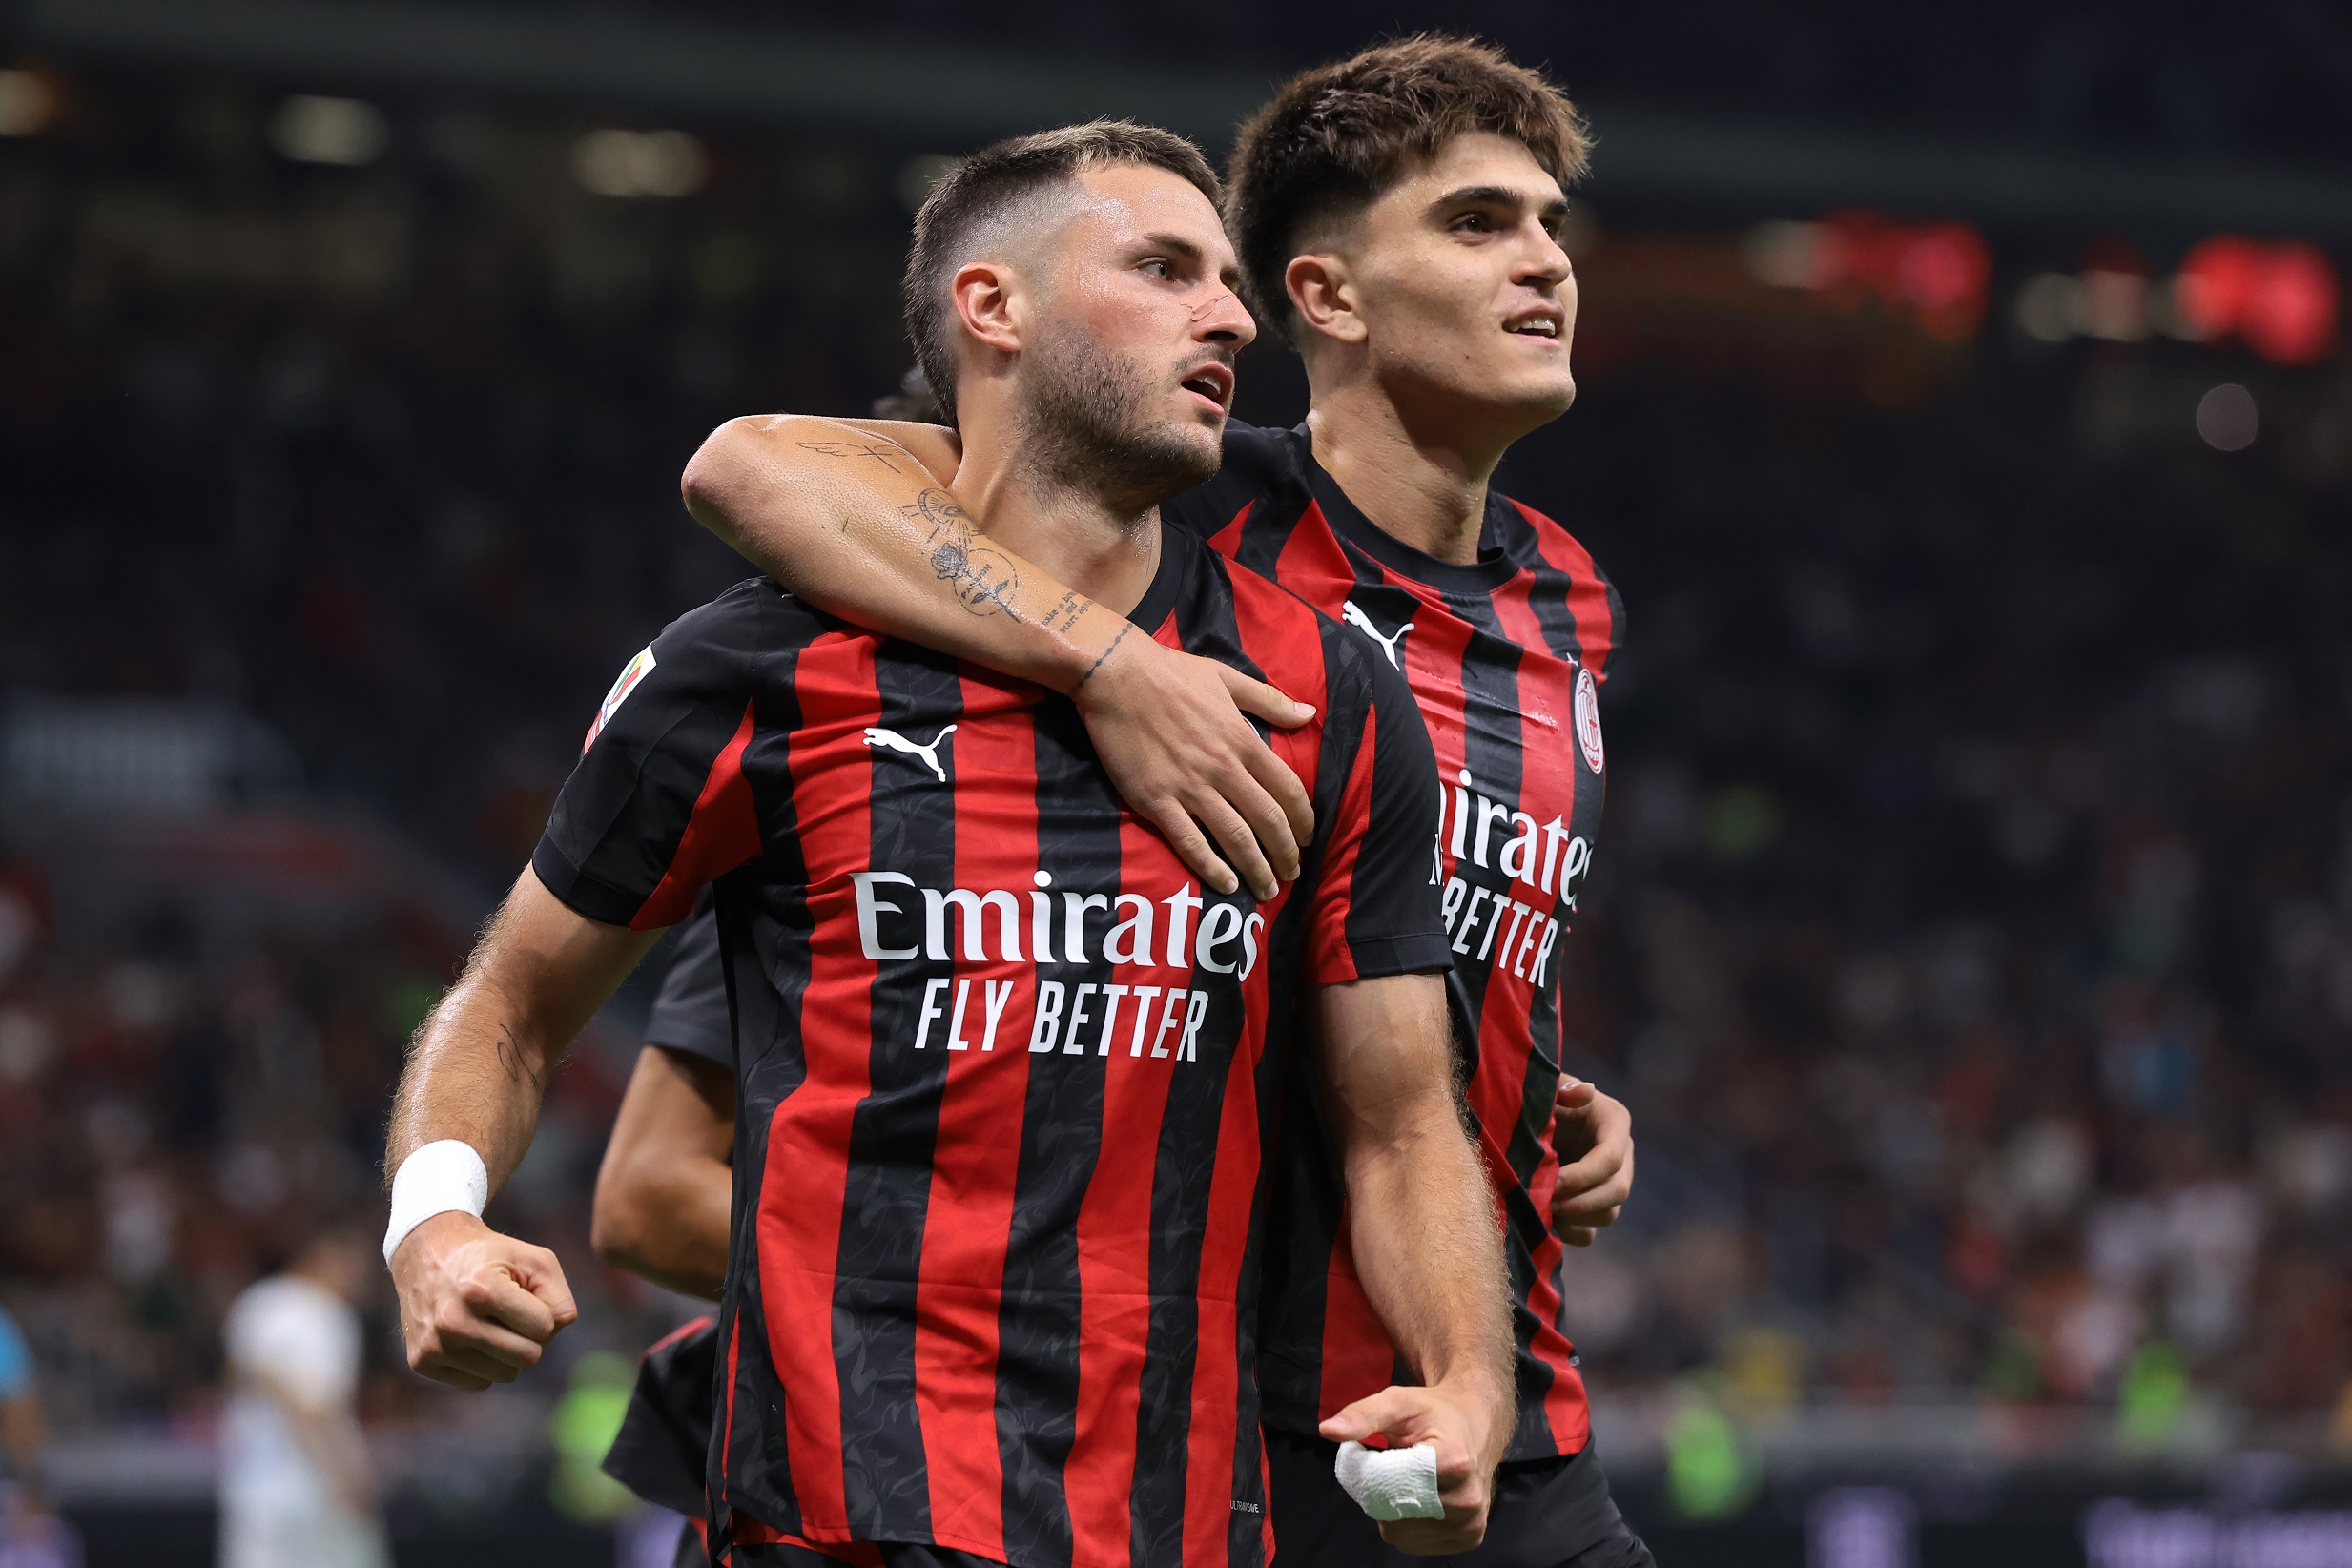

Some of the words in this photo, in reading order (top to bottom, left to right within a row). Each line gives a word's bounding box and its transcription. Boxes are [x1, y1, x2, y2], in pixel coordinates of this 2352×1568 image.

[1060, 615, 1079, 633] start
[1438, 769, 1594, 911] irate
[849, 870, 1265, 982] Emirates
[1442, 876, 1558, 988] BETTER
[914, 978, 1014, 1051] FLY
[1028, 980, 1209, 1063] BETTER
